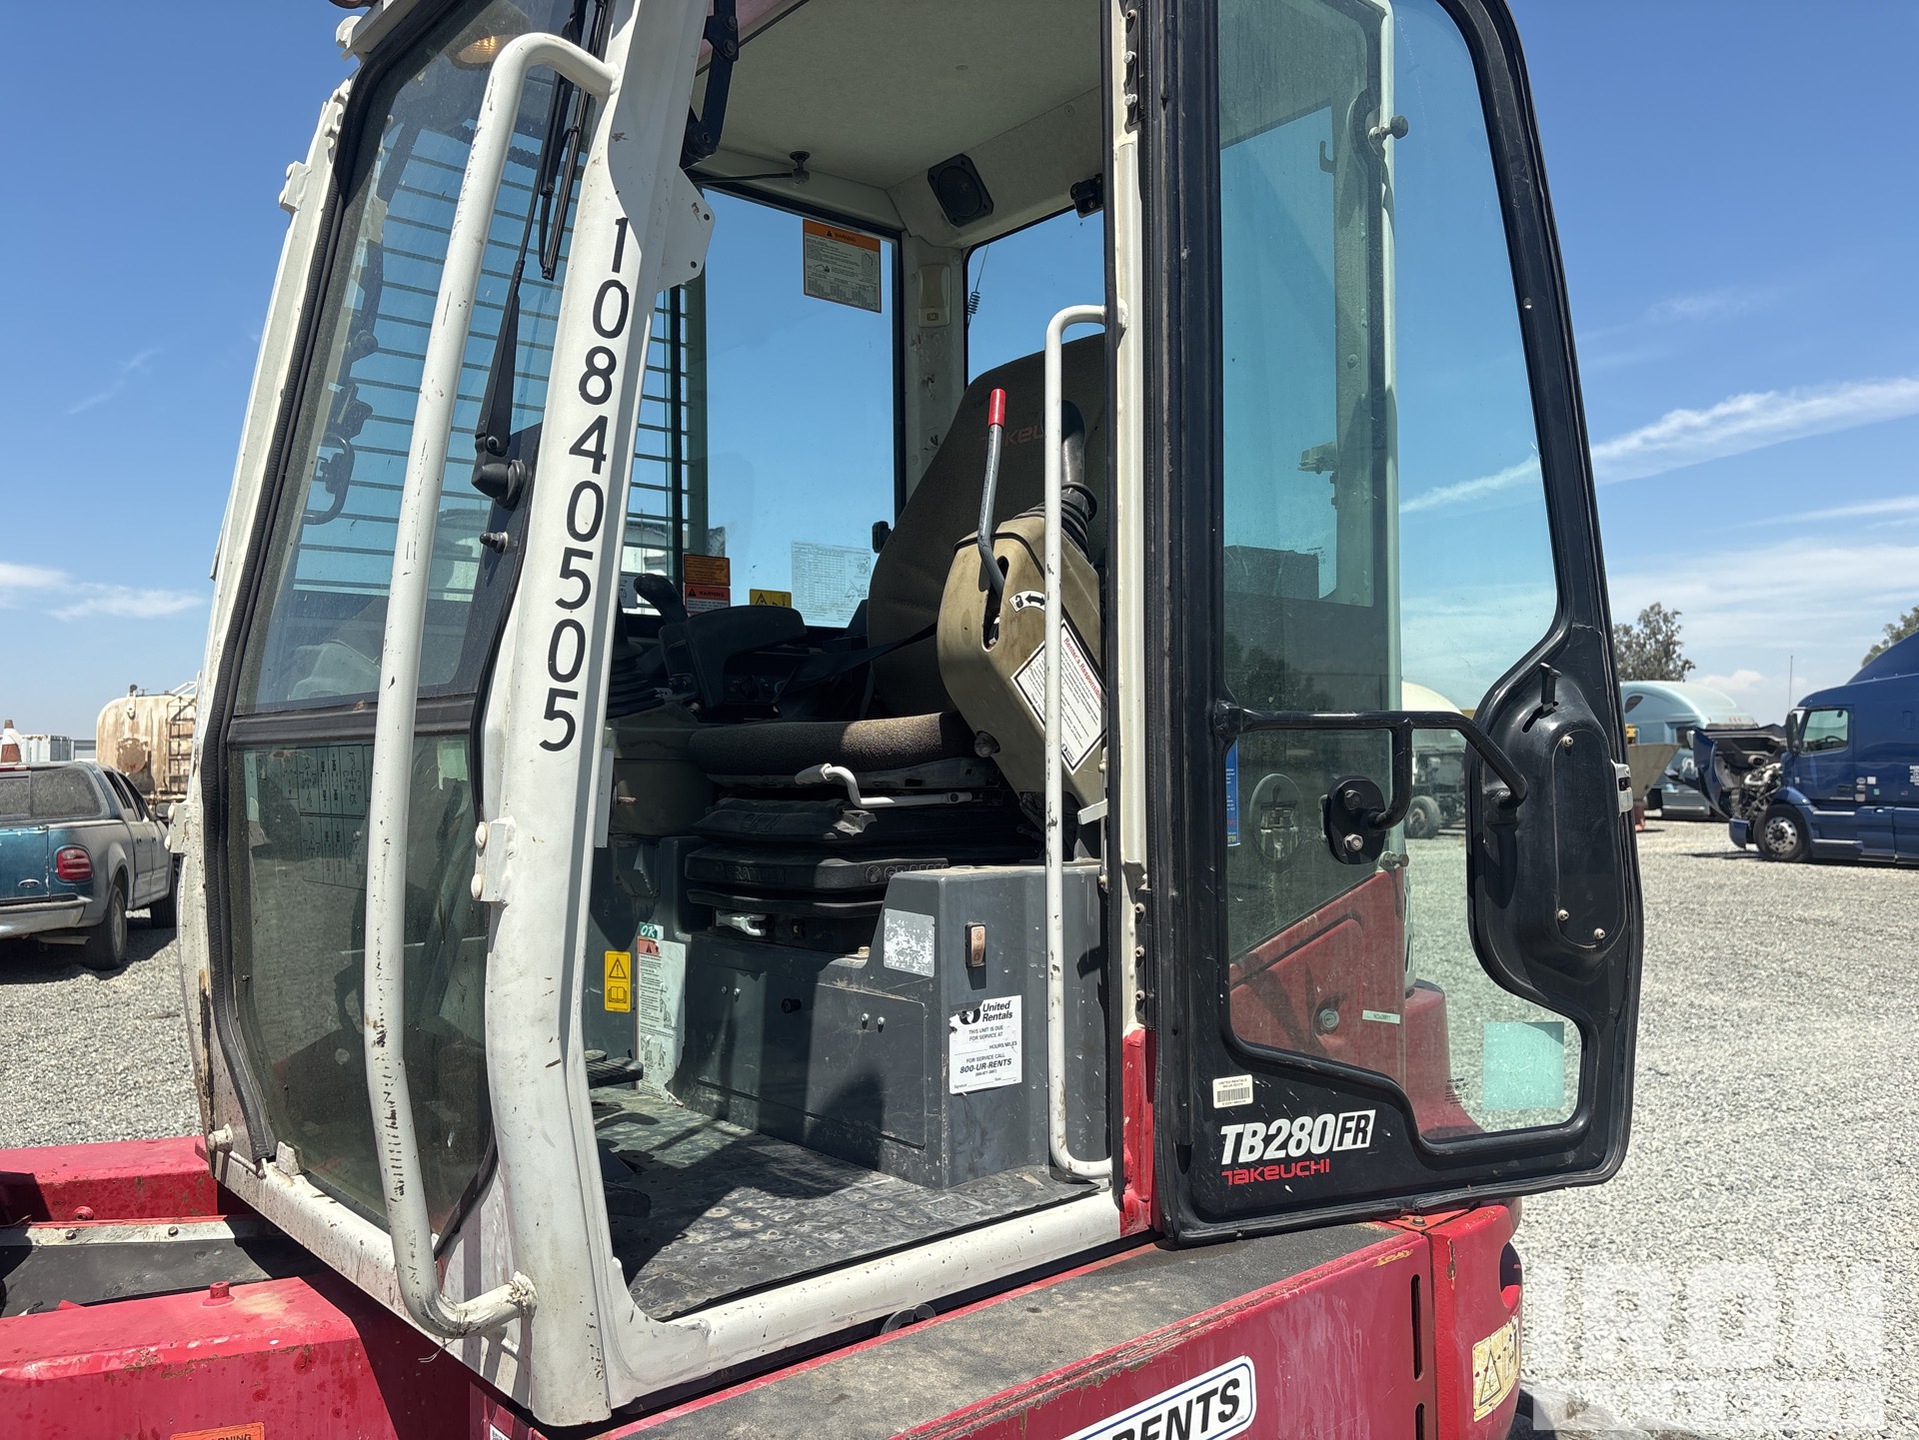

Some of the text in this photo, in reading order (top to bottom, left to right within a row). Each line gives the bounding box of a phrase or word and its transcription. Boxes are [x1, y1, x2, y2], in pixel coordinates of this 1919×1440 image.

[539, 216, 630, 753] 10840505
[640, 924, 655, 938] OK
[982, 1000, 1012, 1012] United
[982, 1011, 1014, 1022] Rentals
[979, 1032, 997, 1040] SERVICE
[976, 1054, 994, 1062] SERVICE
[959, 1057, 1012, 1074] 800-UR-RENTS
[1220, 1111, 1375, 1165] TB280FR
